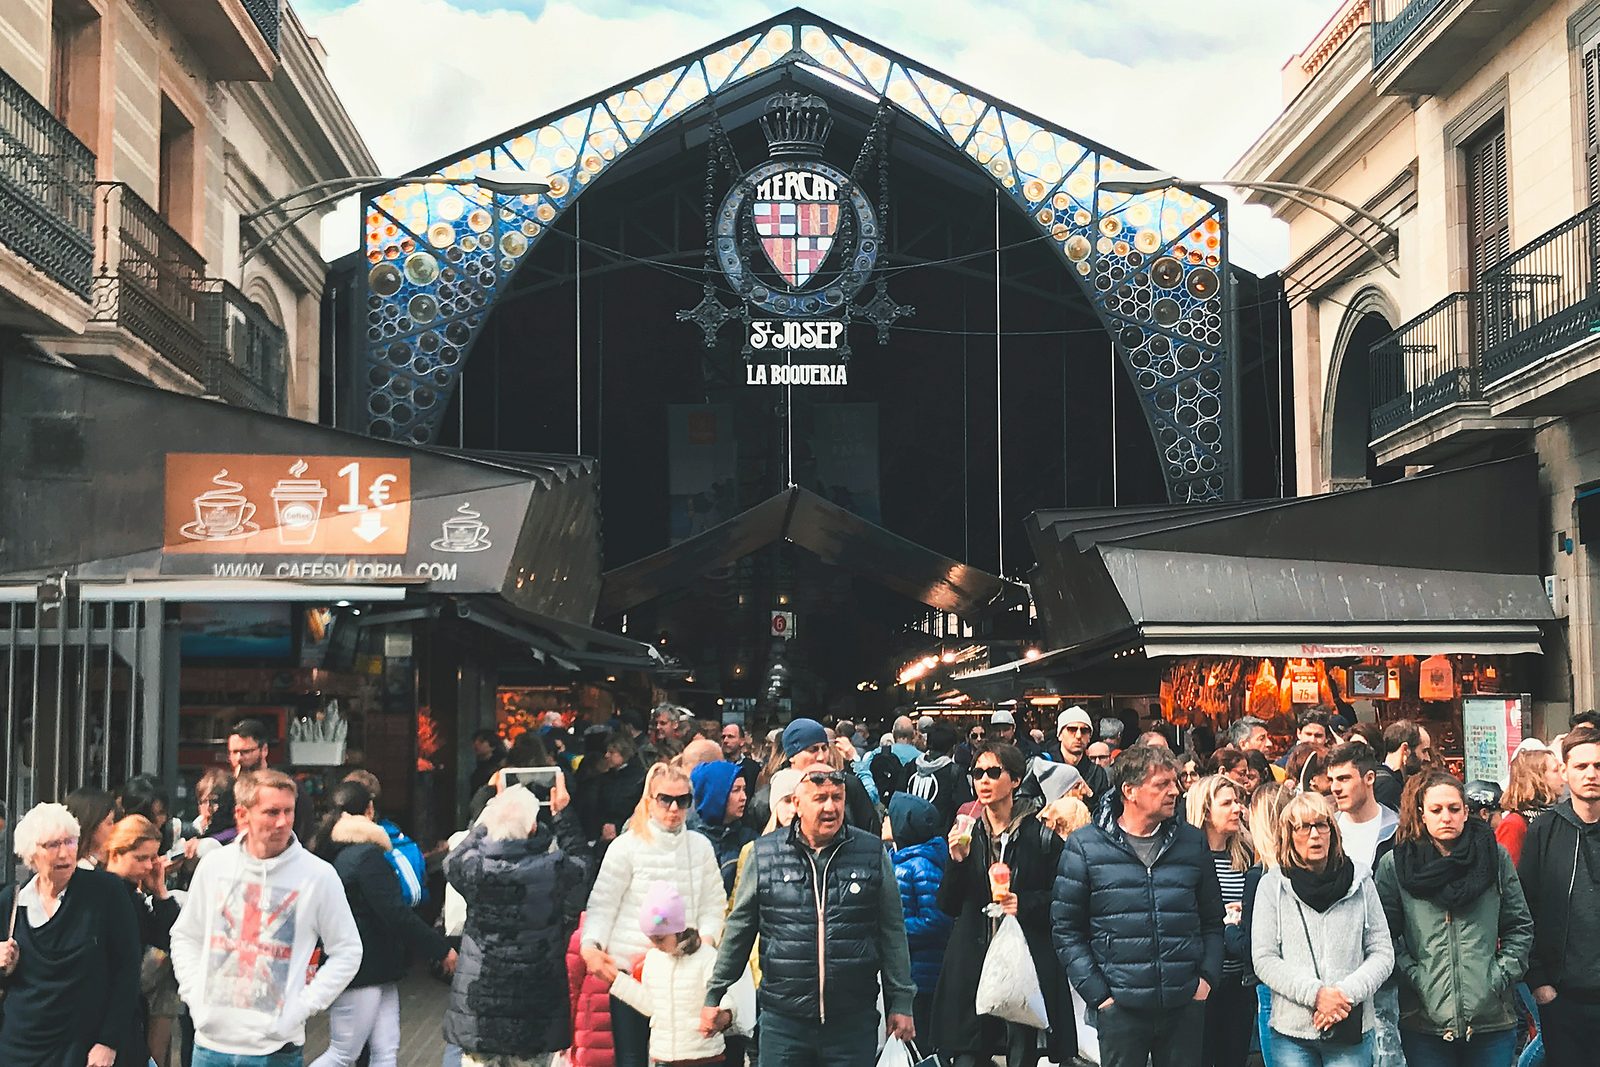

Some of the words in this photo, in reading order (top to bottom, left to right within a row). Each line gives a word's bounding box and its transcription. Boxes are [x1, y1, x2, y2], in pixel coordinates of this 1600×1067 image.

[756, 171, 838, 201] MERCAT
[771, 321, 844, 349] JOSEP
[746, 364, 767, 385] LA
[770, 364, 848, 385] BOQUERIA
[337, 462, 397, 512] 1€
